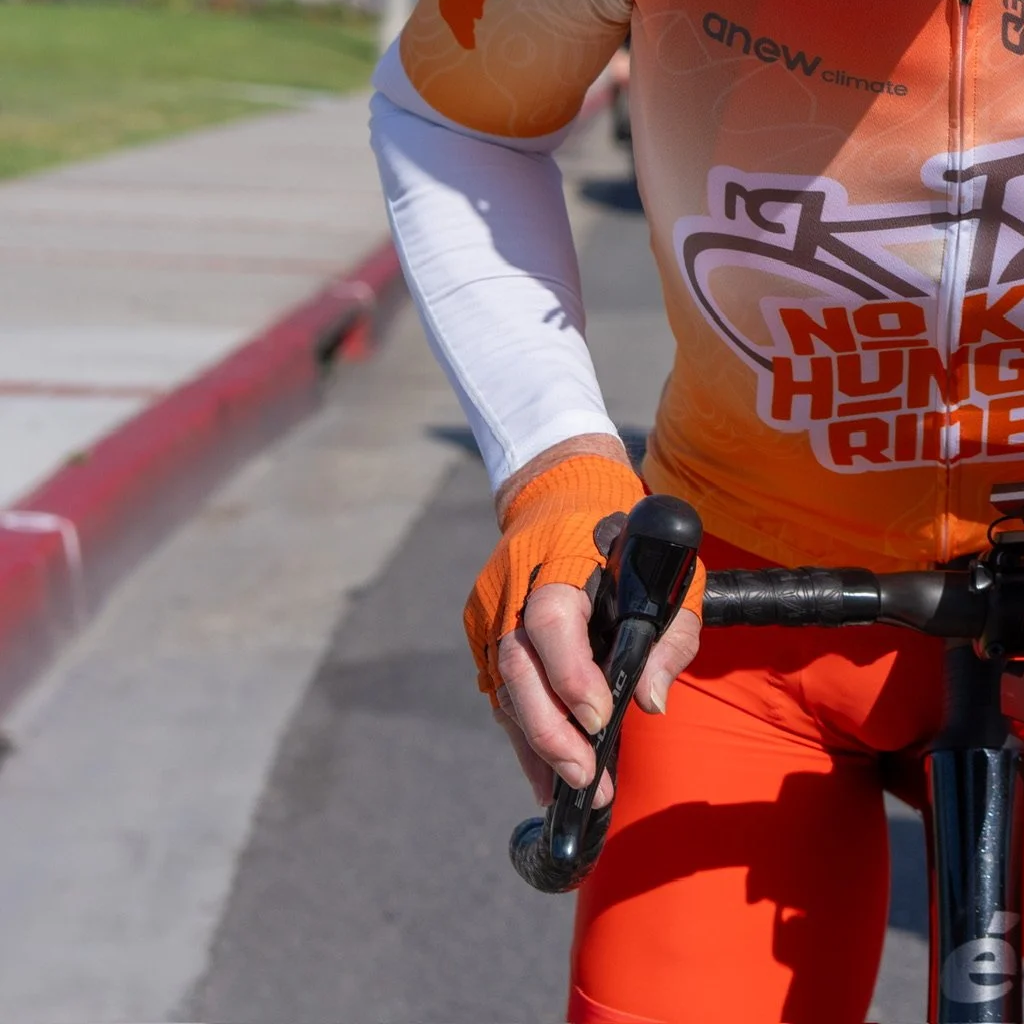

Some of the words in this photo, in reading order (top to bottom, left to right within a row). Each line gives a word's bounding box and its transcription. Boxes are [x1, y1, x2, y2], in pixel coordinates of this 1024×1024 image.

[702, 11, 822, 77] anew
[821, 68, 908, 96] climate
[779, 301, 929, 356] NO
